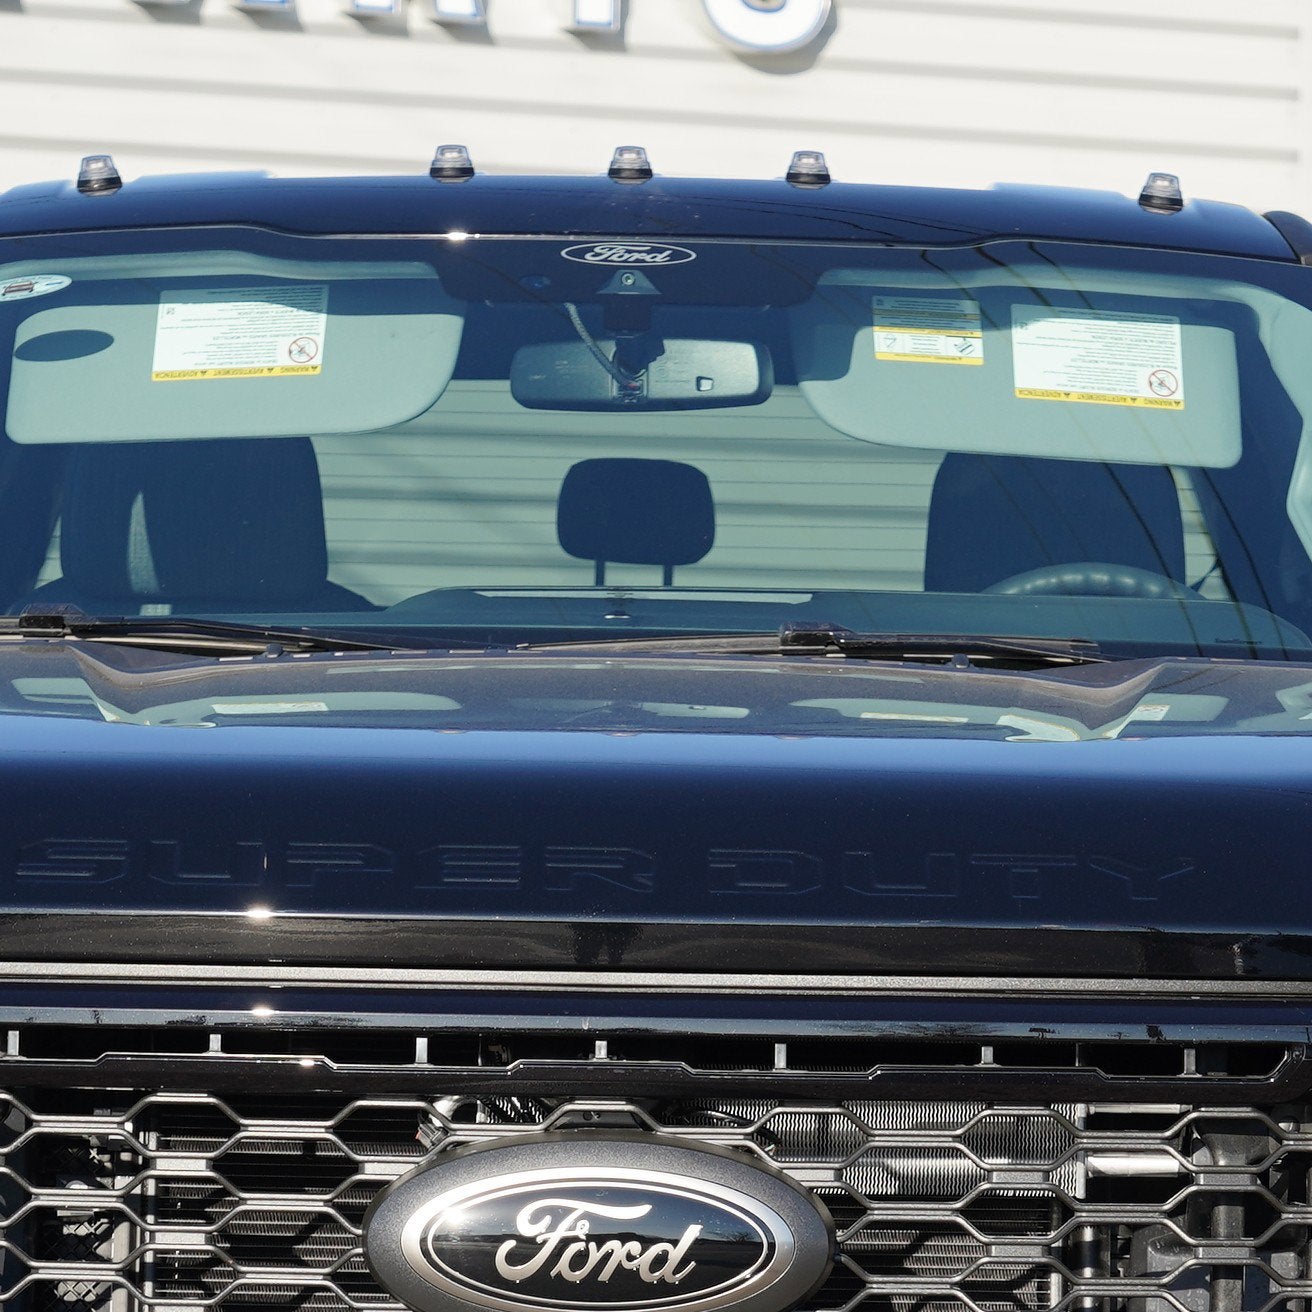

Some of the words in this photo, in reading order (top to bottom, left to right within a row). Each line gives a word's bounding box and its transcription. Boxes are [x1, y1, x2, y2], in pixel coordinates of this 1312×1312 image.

[584, 244, 672, 263] Ford
[15, 837, 657, 893] SUPER
[707, 847, 1197, 901] DUTY
[495, 1197, 704, 1285] Ford
